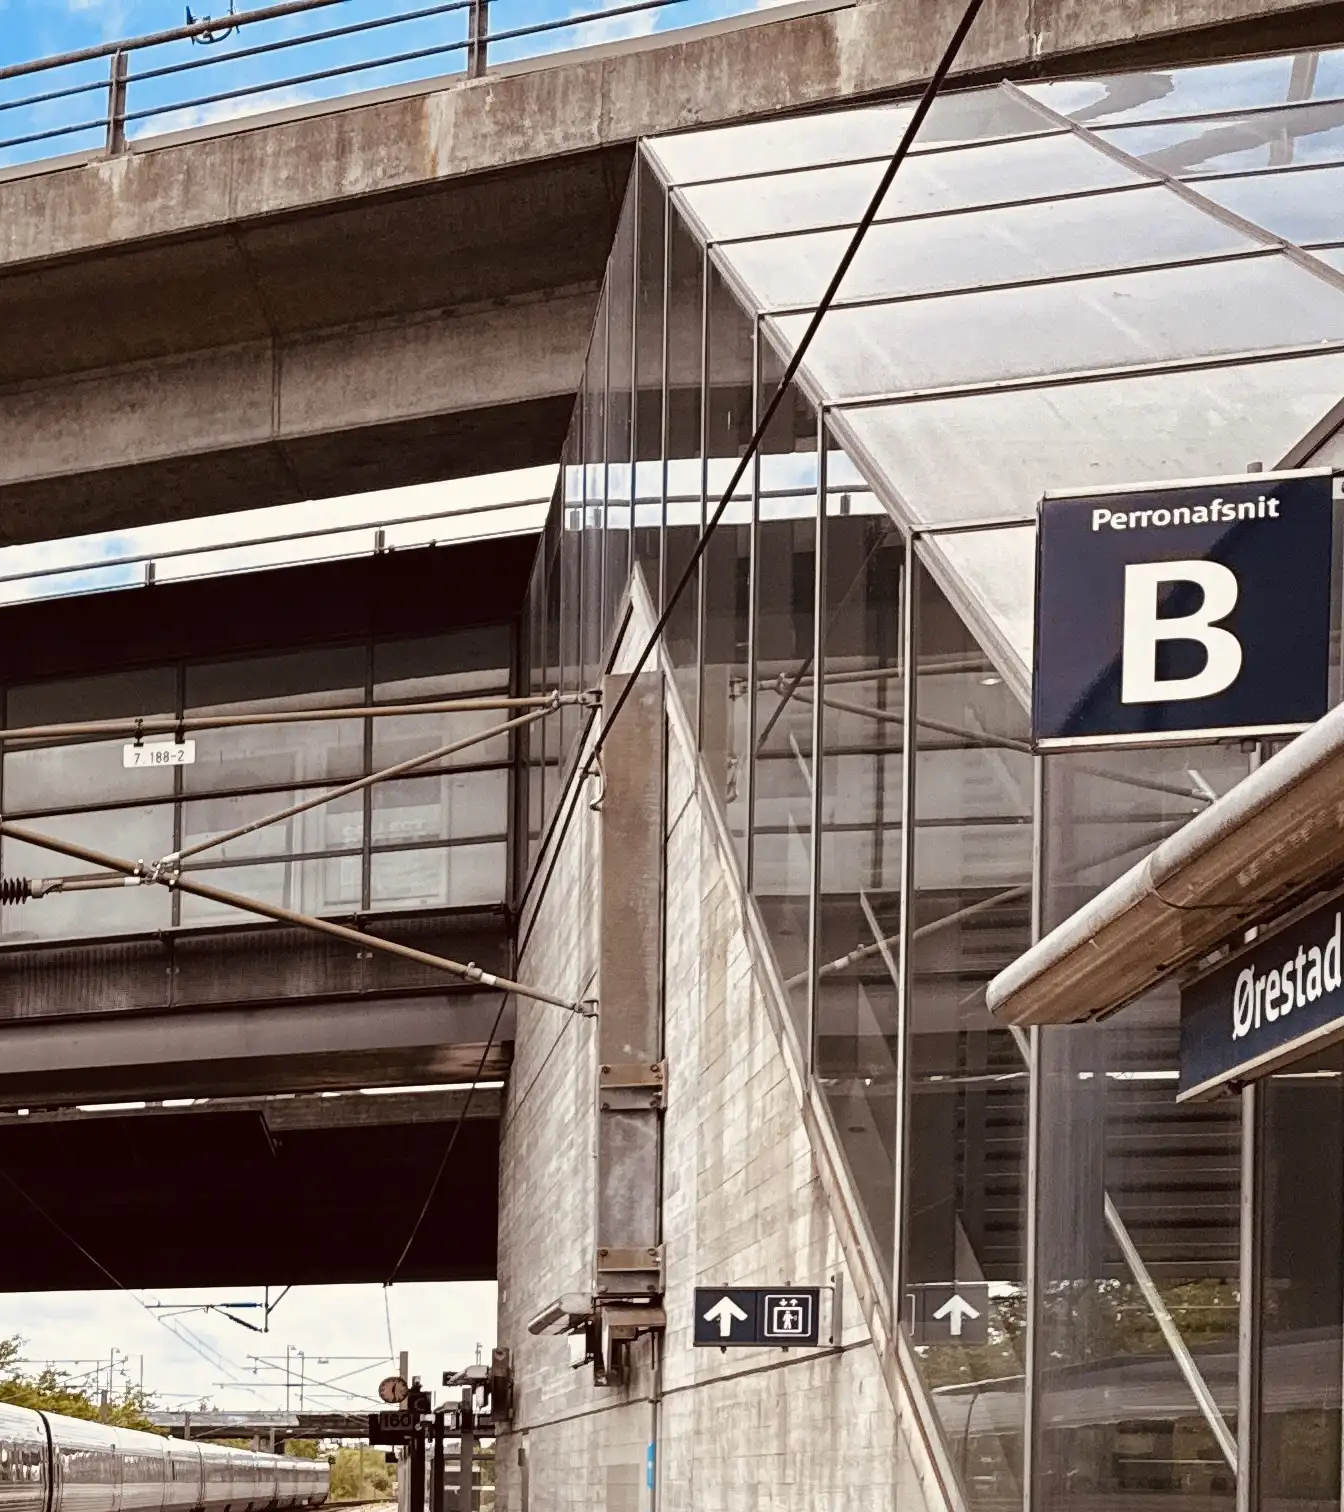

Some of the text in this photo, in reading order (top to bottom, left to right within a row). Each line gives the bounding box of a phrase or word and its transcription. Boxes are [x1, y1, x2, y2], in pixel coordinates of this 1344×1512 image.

[1092, 496, 1280, 532] Perronafsnit
[1121, 559, 1243, 704] B
[1232, 911, 1342, 1041] Ørestad
